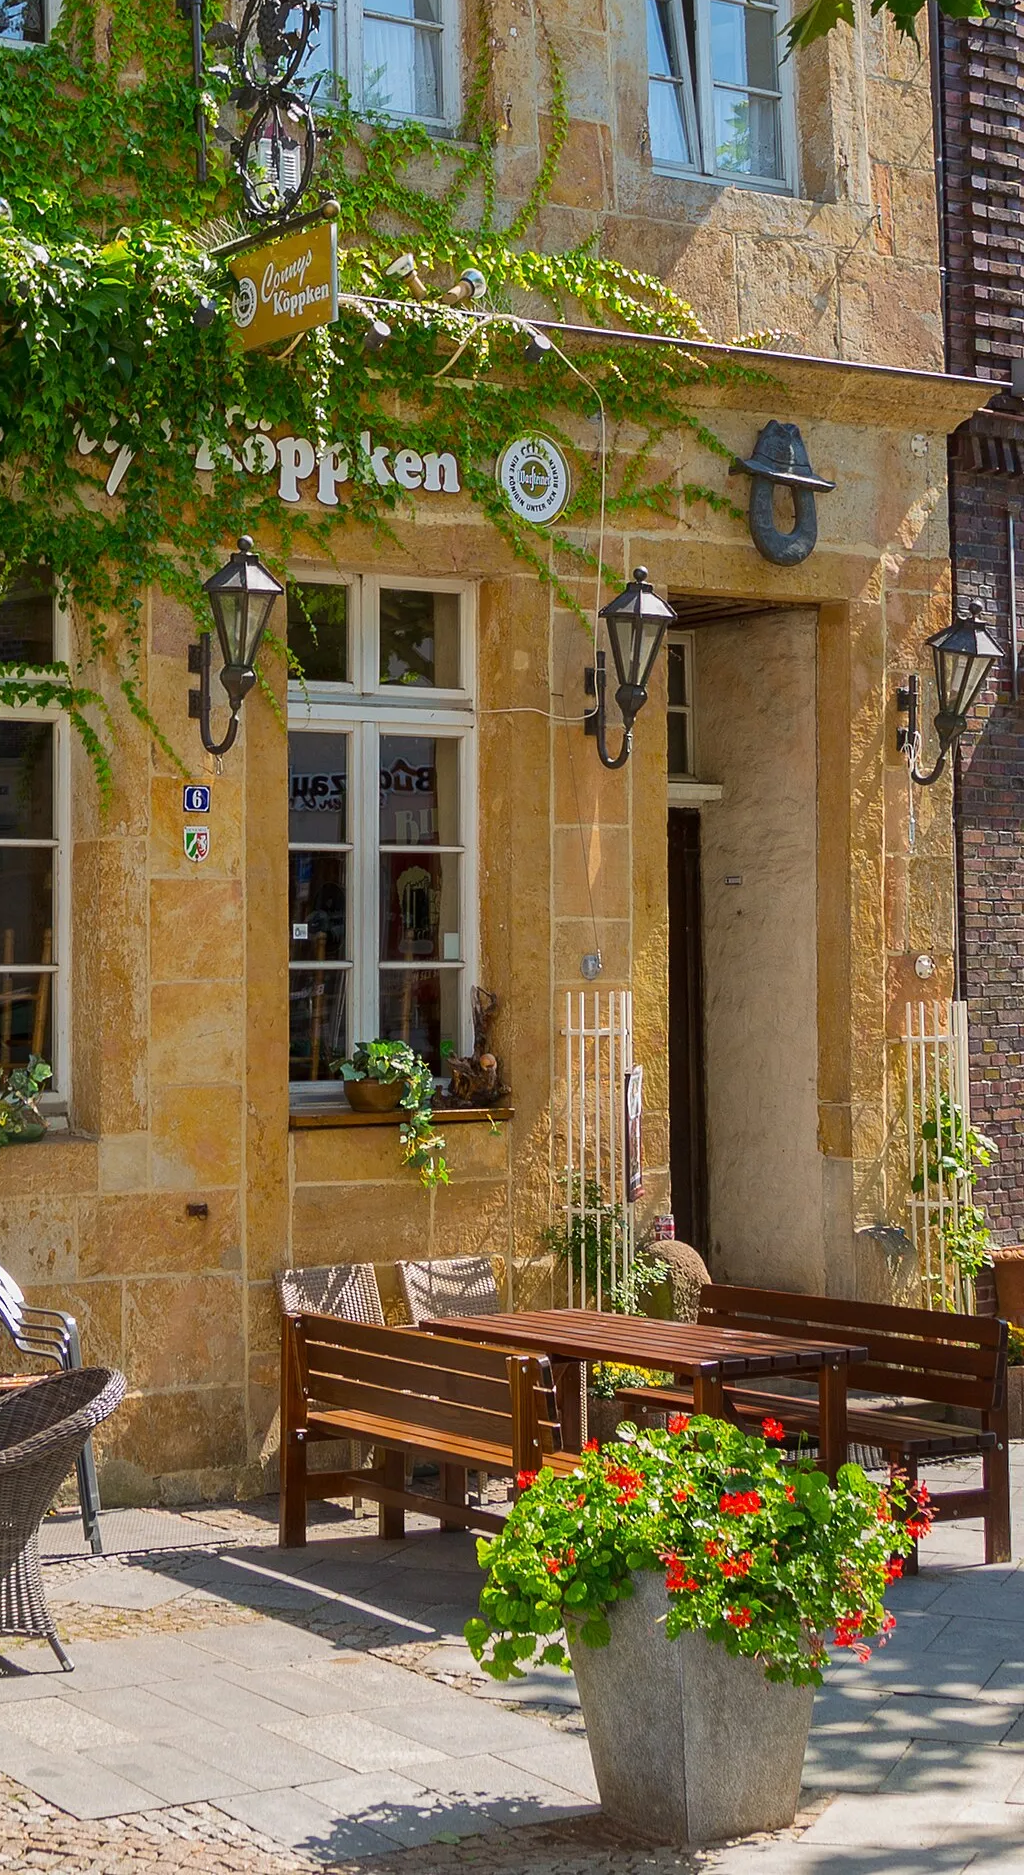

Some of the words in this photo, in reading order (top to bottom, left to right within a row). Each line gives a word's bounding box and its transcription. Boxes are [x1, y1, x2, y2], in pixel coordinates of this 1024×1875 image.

[273, 282, 330, 318] Köppken
[509, 455, 519, 473] EINE
[526, 503, 546, 512] UNTER
[546, 491, 557, 506] DEN
[192, 789, 202, 808] 6
